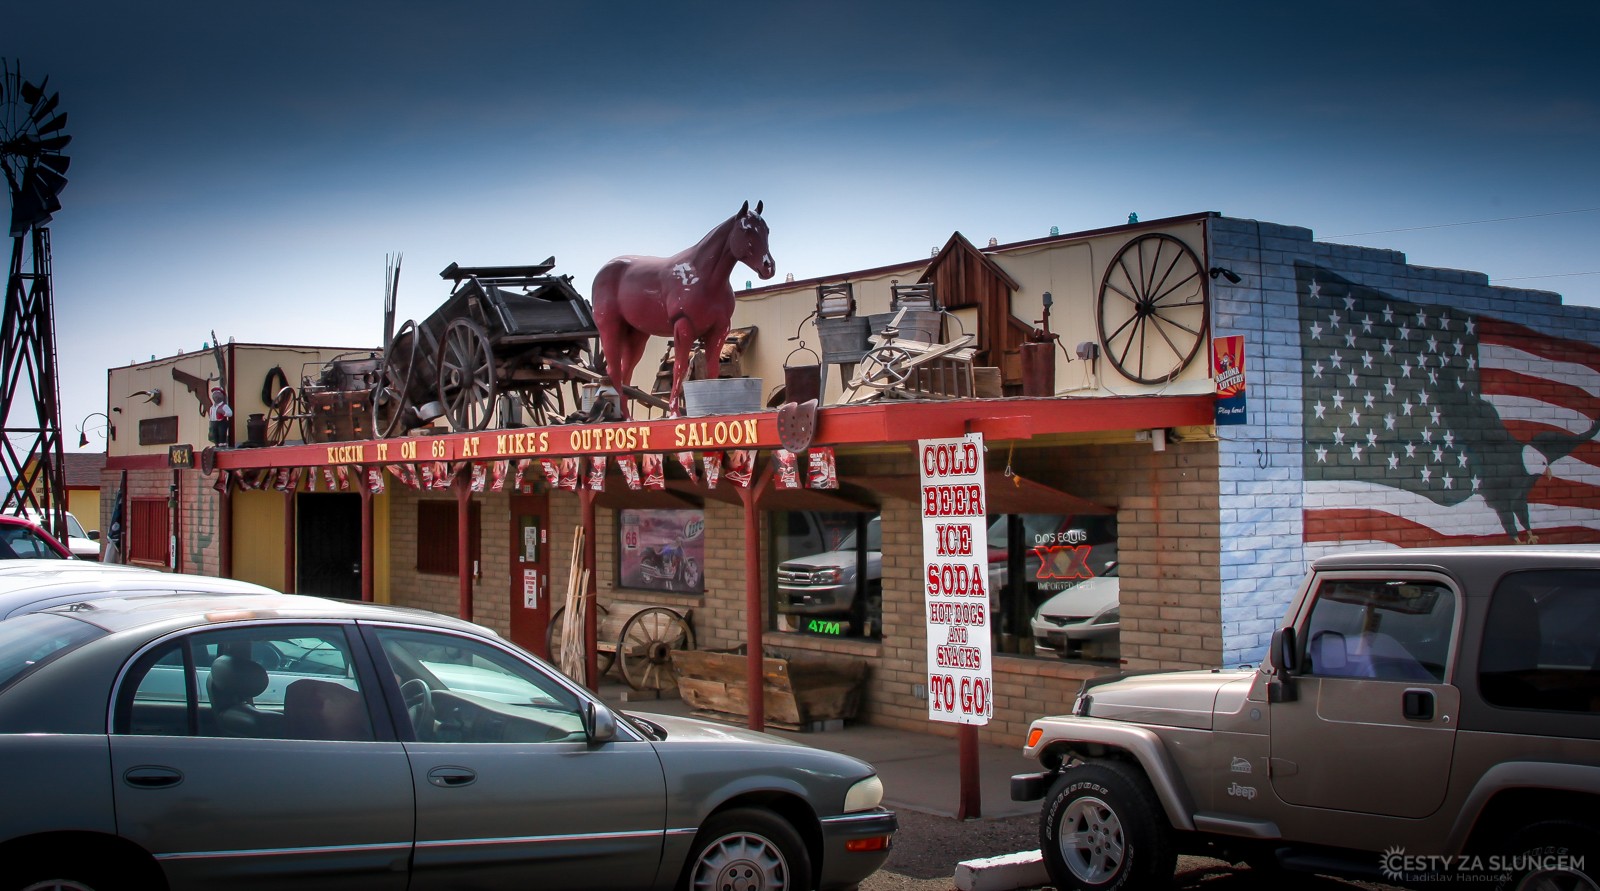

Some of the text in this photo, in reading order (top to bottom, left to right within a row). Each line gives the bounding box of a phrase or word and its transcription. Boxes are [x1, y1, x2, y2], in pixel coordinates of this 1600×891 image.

[1215, 366, 1240, 383] ARIZONA
[1219, 373, 1244, 391] LOTTERY
[1218, 405, 1245, 415] Play here!
[327, 419, 758, 464] KICKIN IT ON 66 AT MIKES OUTPOST SALOON
[923, 442, 979, 478] COLD
[923, 484, 985, 518] BEER
[625, 531, 637, 546] 66
[935, 523, 973, 557] ICE
[1034, 531, 1087, 544] DOS EQUIS
[927, 563, 986, 598] SODA
[929, 601, 986, 627] HOT DOGS
[808, 619, 840, 635] ATM
[947, 625, 969, 645] AND
[937, 645, 982, 670] SNACKS
[930, 673, 991, 717] TO GO!
[1227, 782, 1257, 800] Jeep
